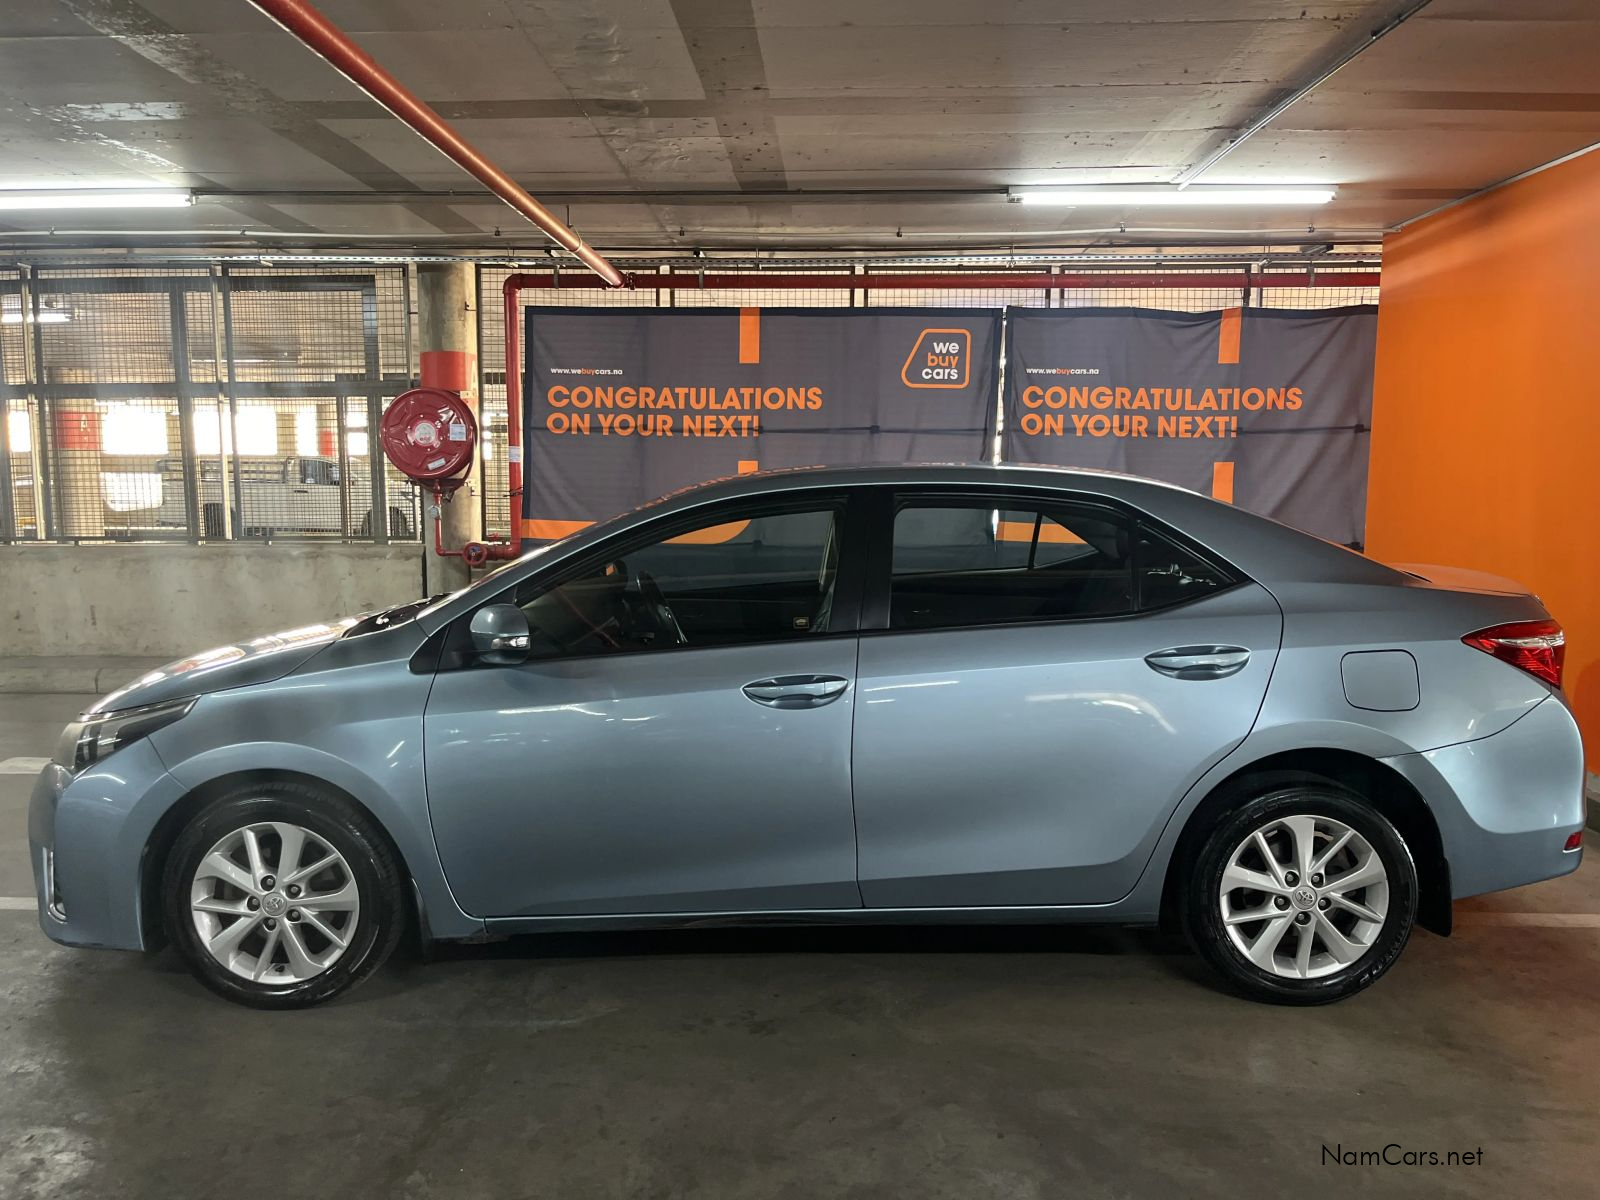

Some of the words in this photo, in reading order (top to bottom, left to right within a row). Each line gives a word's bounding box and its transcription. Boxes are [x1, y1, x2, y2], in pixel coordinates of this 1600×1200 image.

[933, 342, 960, 354] we
[927, 352, 959, 369] buy
[550, 367, 623, 376] www.webuycars.na
[921, 368, 959, 380] cars
[1025, 367, 1100, 375] www.webuycars.na
[547, 385, 823, 410] CONGRATULATIONS
[1022, 385, 1303, 411] CONGRATULATIONS
[546, 412, 590, 435] ON
[597, 413, 674, 437] YOUR
[682, 415, 759, 437] NEXT!
[1020, 413, 1064, 436] ON
[1071, 414, 1149, 437] YOUR
[1157, 415, 1238, 438] NEXT!
